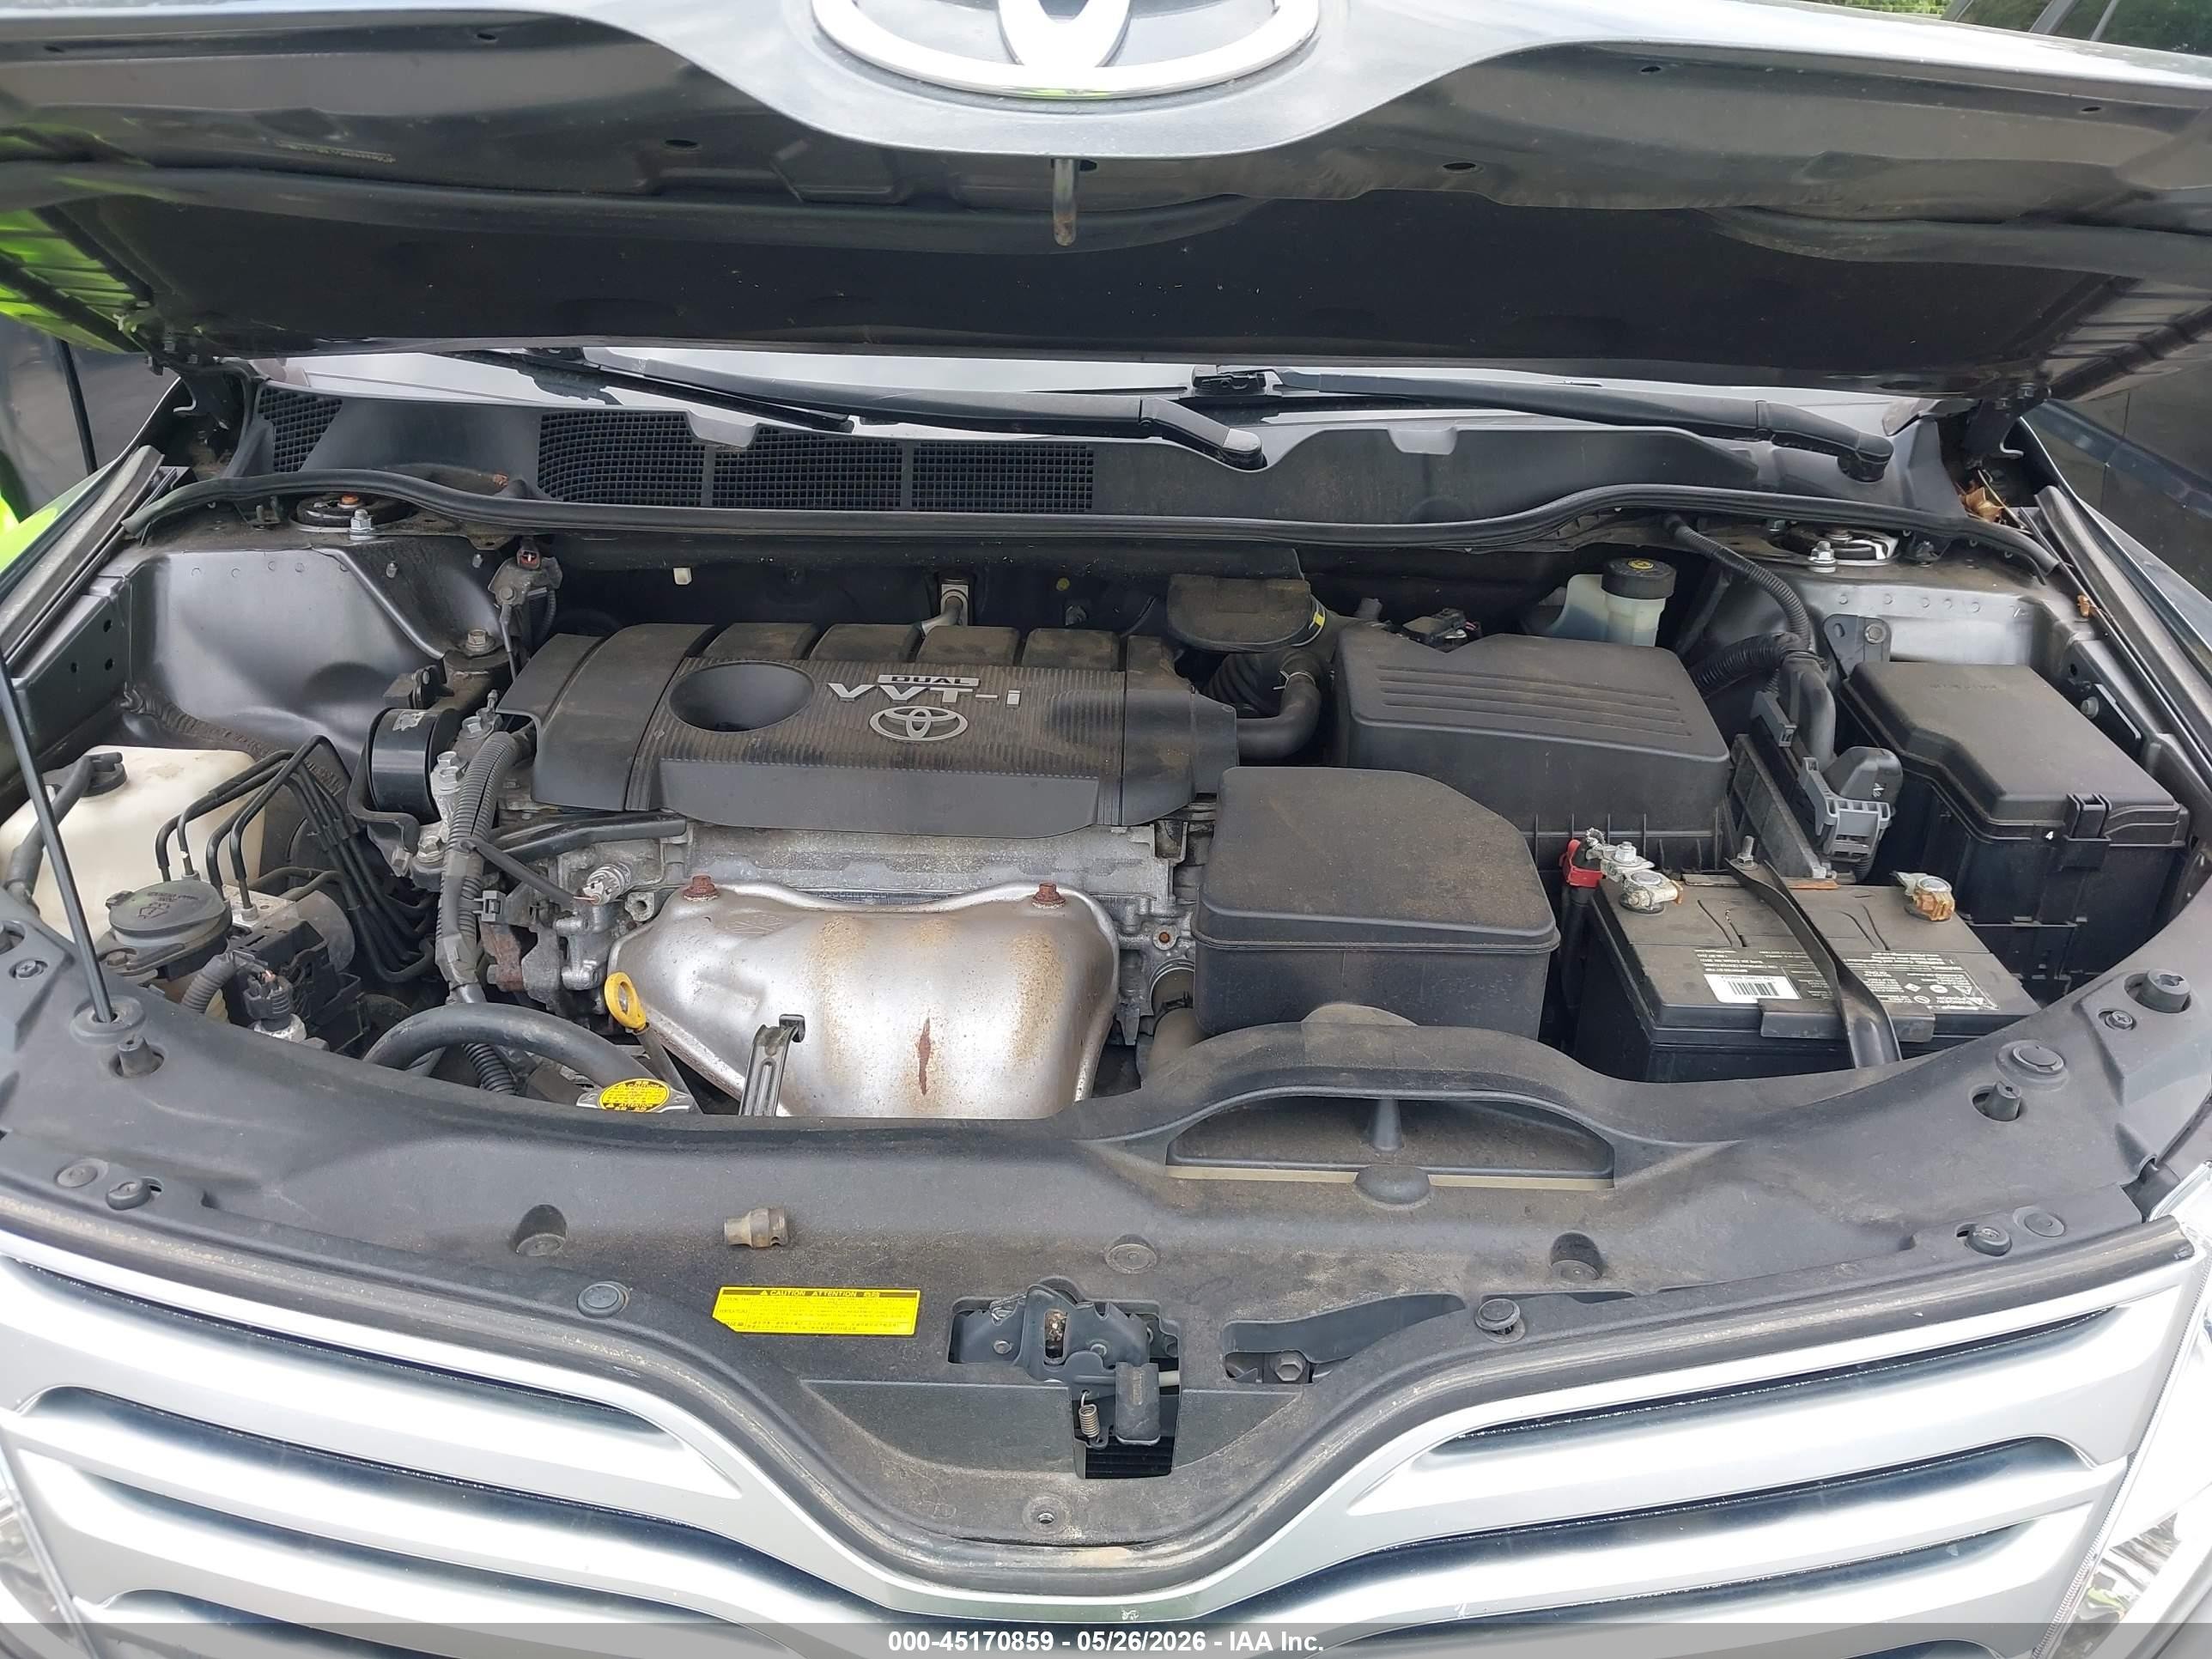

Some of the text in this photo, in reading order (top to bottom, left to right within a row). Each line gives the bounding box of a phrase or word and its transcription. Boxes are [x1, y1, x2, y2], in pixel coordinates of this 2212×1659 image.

[891, 676, 970, 685] DUAL
[828, 683, 1021, 707] VVT-i
[2045, 830, 2055, 841] 4
